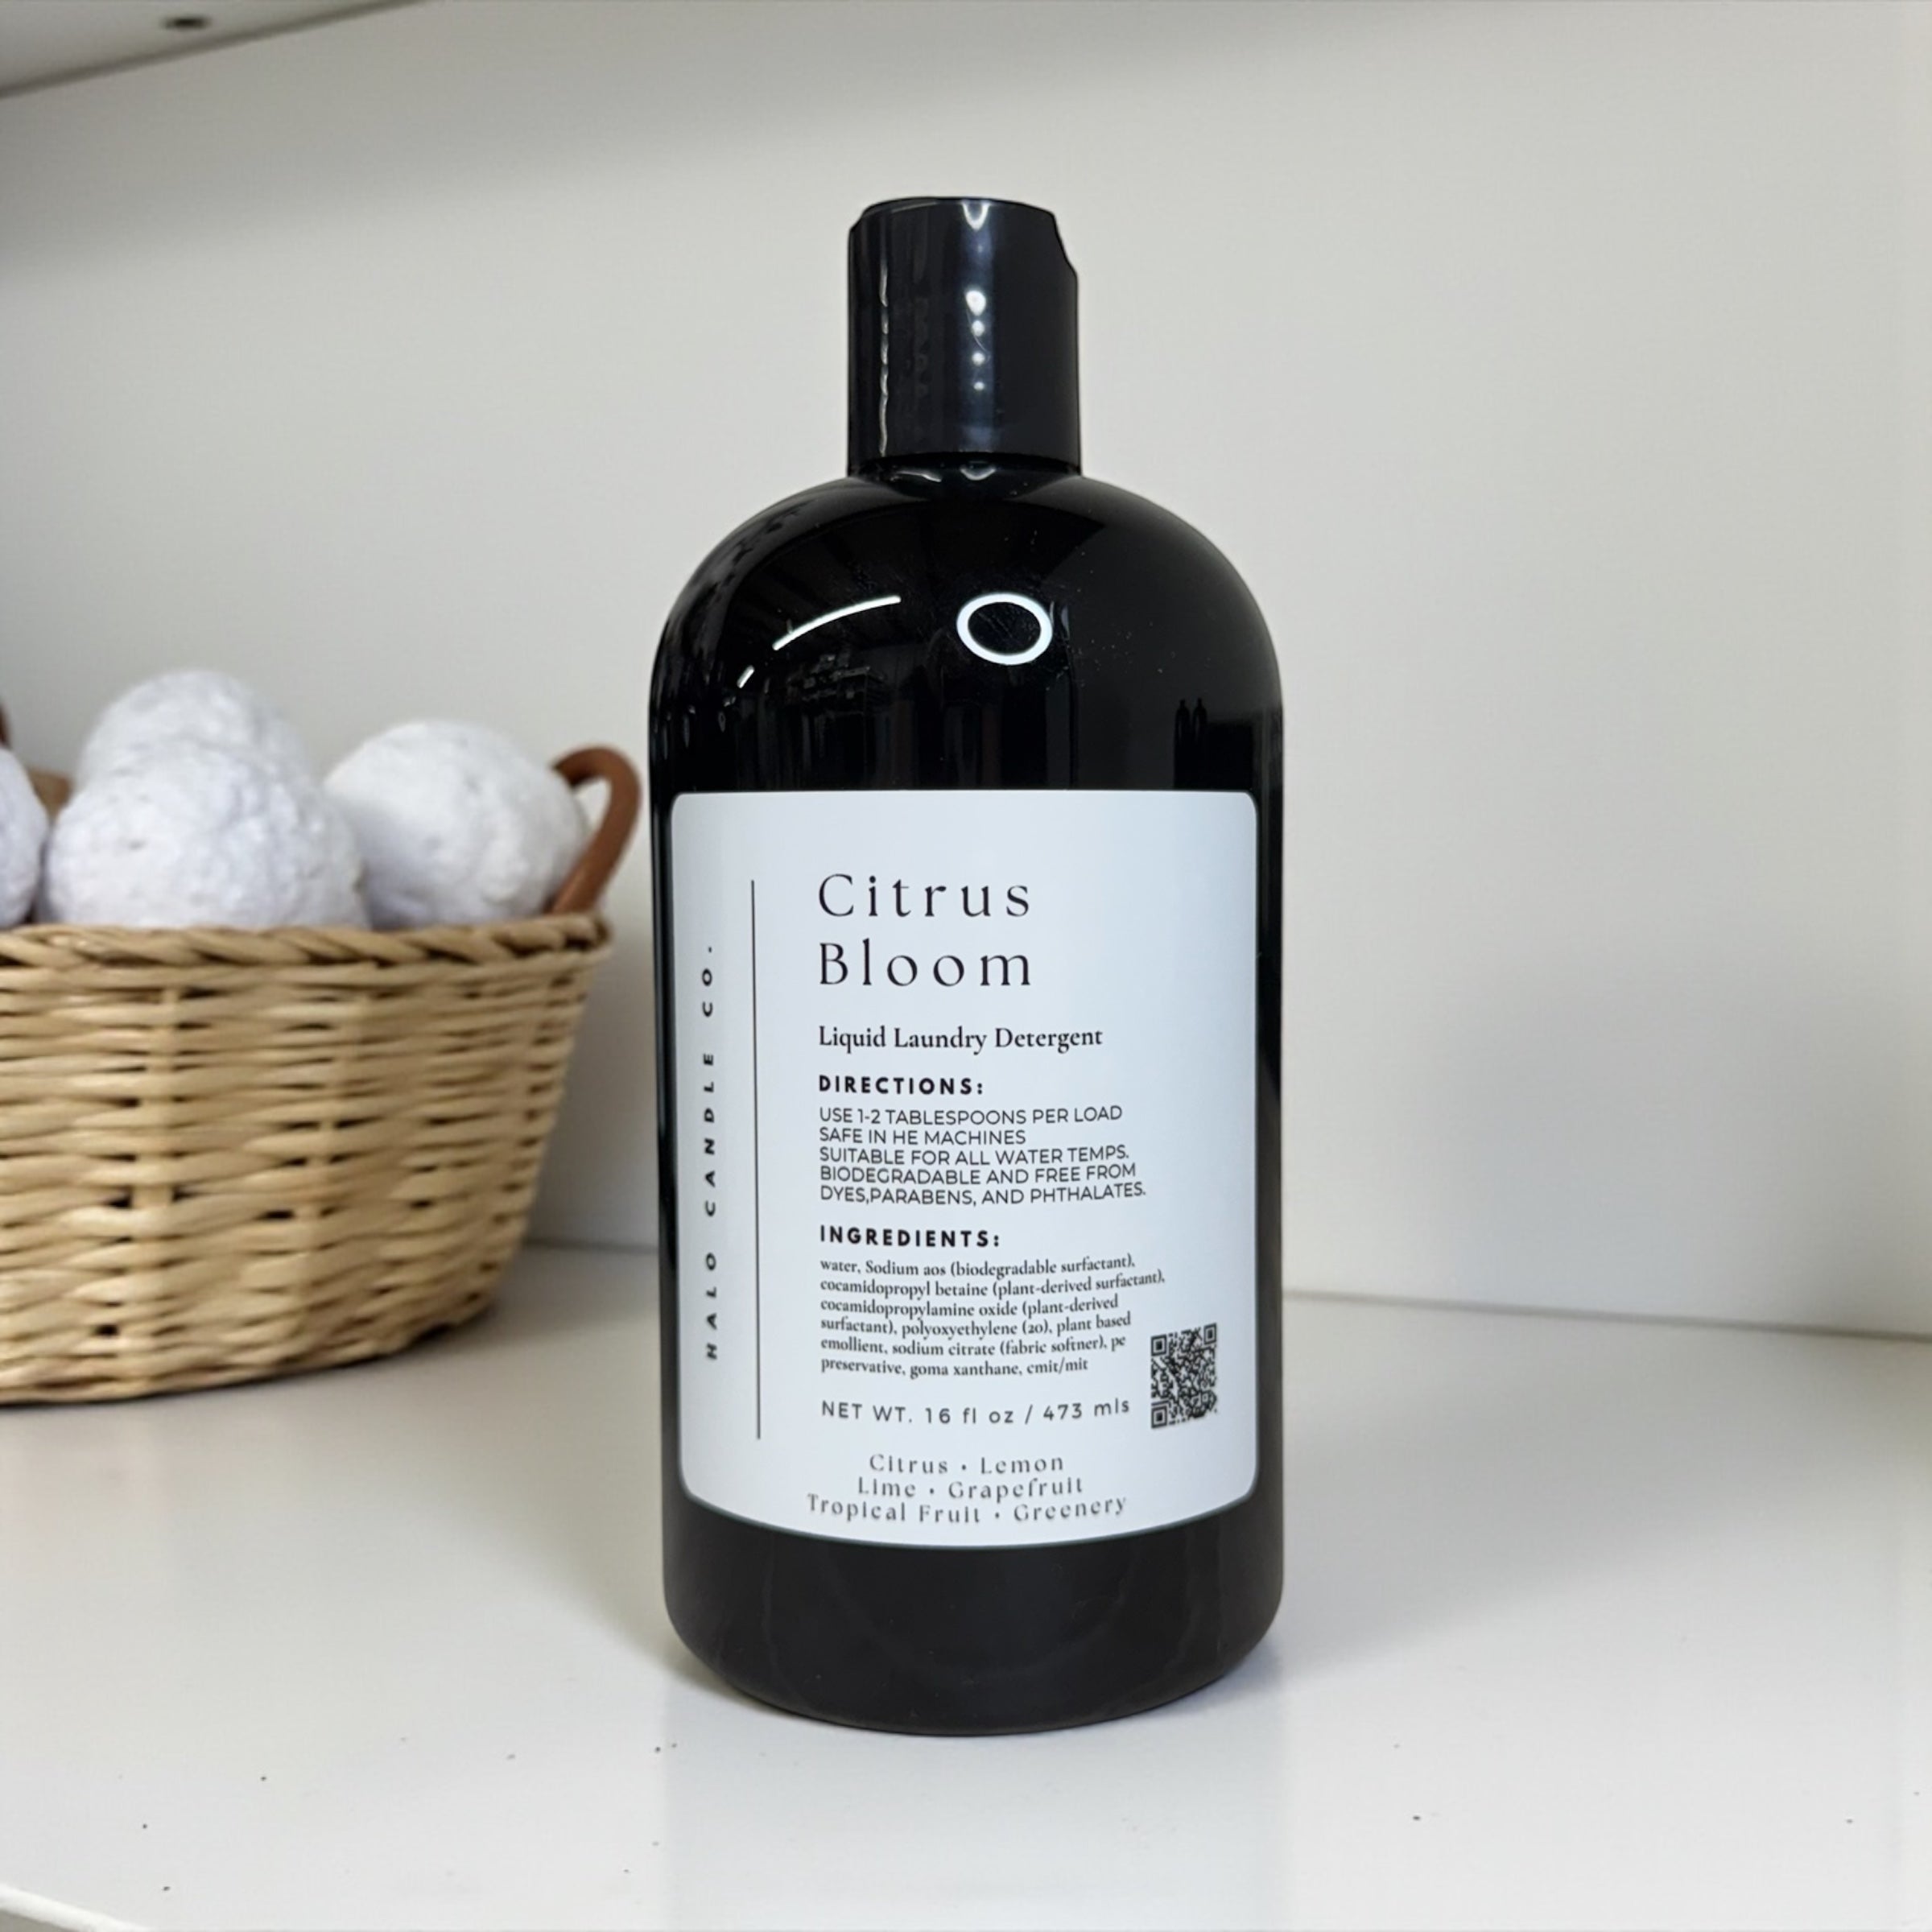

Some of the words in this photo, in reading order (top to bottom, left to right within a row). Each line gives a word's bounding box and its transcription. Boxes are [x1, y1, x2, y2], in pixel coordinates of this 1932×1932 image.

[819, 874, 1030, 917] Citrus
[819, 939, 1031, 987] Bloom
[701, 947, 714, 1018] CO.
[819, 1025, 886, 1054] Liquid
[894, 1026, 987, 1055] Laundry
[995, 1027, 1103, 1053] Detergent
[819, 1075, 983, 1095] DIRECTIONS:
[819, 1107, 852, 1123] USE
[858, 1108, 881, 1124] 1-2
[886, 1109, 1026, 1125] TABLESPOONS
[1033, 1108, 1068, 1124] PER
[1075, 1105, 1122, 1122] LOAD
[703, 1054, 716, 1217] CANDLE
[819, 1127, 863, 1143] SAFE
[869, 1129, 886, 1144] IN
[894, 1130, 918, 1145] HE
[925, 1129, 1026, 1146] MACHINES
[819, 1146, 905, 1165] SUITABLE
[911, 1150, 950, 1165] FOR
[955, 1150, 990, 1165] ALL
[995, 1149, 1063, 1165] WATER
[1067, 1145, 1129, 1162] TEMPS.
[820, 1166, 981, 1185] BIODEGRADABLE
[986, 1169, 1029, 1184] AND
[1035, 1166, 1080, 1183] FREE
[1087, 1162, 1136, 1180] FROM
[981, 1189, 1024, 1204] AND
[1030, 1182, 1146, 1203] PHTHALATES.
[820, 1224, 999, 1248] INGREDIENTS:
[820, 1260, 861, 1274] water,
[865, 1260, 919, 1276] Sodium
[923, 1266, 946, 1276] aos
[951, 1259, 1057, 1280] (biodegradable
[1061, 1253, 1136, 1273] surfactant),
[820, 1278, 930, 1300] cocamidopropyl
[935, 1281, 989, 1296] betaine
[993, 1276, 1092, 1300] (plant-derived
[1096, 1269, 1166, 1290] surfactant),
[706, 1252, 717, 1360] HALO
[820, 1298, 975, 1321] cocamidopropylamine
[979, 1300, 1018, 1315] oxide
[1022, 1293, 1118, 1319] (plant-derived
[820, 1315, 898, 1335] surfactant),
[902, 1320, 1018, 1340] polyoxyethylene
[1022, 1319, 1053, 1335] (20),
[1057, 1316, 1092, 1337] plant
[1096, 1311, 1131, 1329] based
[820, 1336, 888, 1355] emollient,
[892, 1340, 944, 1356] sodium
[948, 1342, 995, 1356] citrate
[1000, 1339, 1047, 1355] (fabric
[1051, 1335, 1108, 1353] softner),
[1111, 1335, 1125, 1352] pe
[821, 1358, 906, 1376] preservative,
[910, 1366, 949, 1380] goma
[953, 1360, 1022, 1376] xanthane,
[1026, 1356, 1088, 1375] cmit/mit
[821, 1400, 863, 1419] NET
[873, 1406, 913, 1423] WT.
[925, 1407, 951, 1425] 16
[962, 1407, 976, 1425] fl
[989, 1410, 1014, 1424] oz
[1025, 1405, 1034, 1425] /
[1042, 1402, 1083, 1422] 473
[1094, 1398, 1129, 1417] mls
[869, 1454, 948, 1475] Citrus
[980, 1456, 1064, 1475] Lemon
[858, 1476, 916, 1498] Lime
[948, 1477, 1083, 1503] Grapefruit
[807, 1493, 906, 1522] Tropical
[919, 1505, 980, 1523] Fruit
[1013, 1496, 1126, 1523] Greenery
